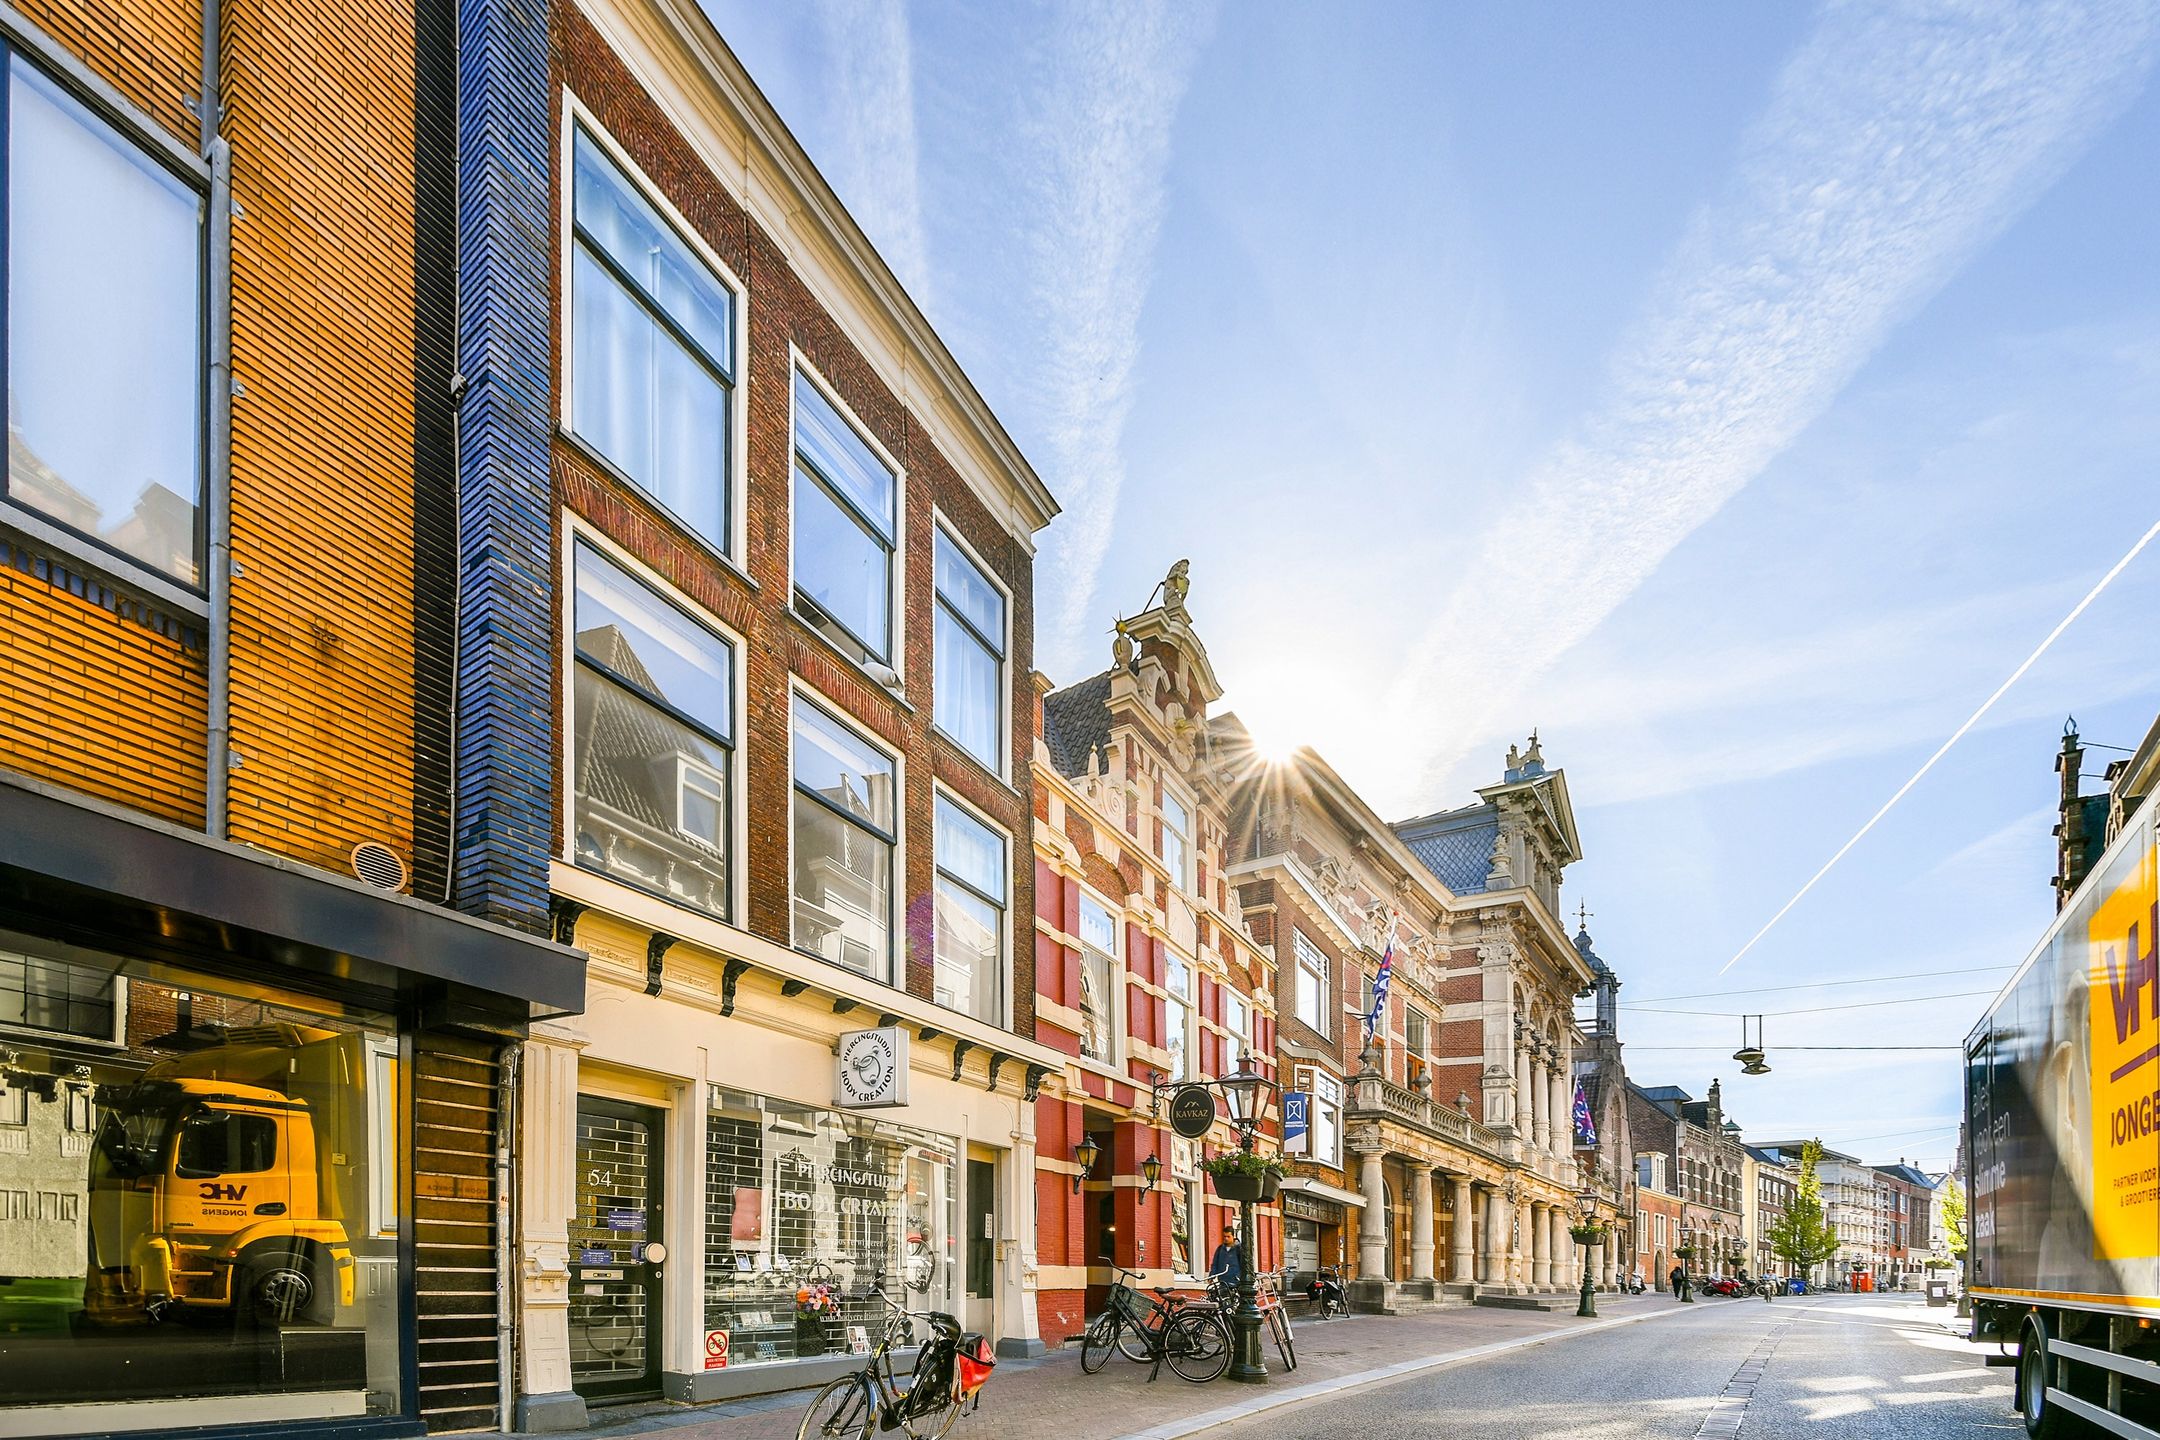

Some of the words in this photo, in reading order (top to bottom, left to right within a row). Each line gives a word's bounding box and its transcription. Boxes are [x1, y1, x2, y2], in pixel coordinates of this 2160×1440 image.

[843, 1032, 892, 1062] PIERCINGSTUDIO
[841, 1070, 858, 1097] BODY
[858, 1065, 894, 1102] CREATION
[1973, 1081, 1990, 1118] alles
[1175, 1109, 1209, 1119] KAVKAZ
[1993, 1111, 2010, 1146] een
[589, 1169, 612, 1188] 54
[1975, 1161, 2006, 1199] slimme
[2140, 1167, 2156, 1183] VOOR
[1975, 1202, 1995, 1239] zaak
